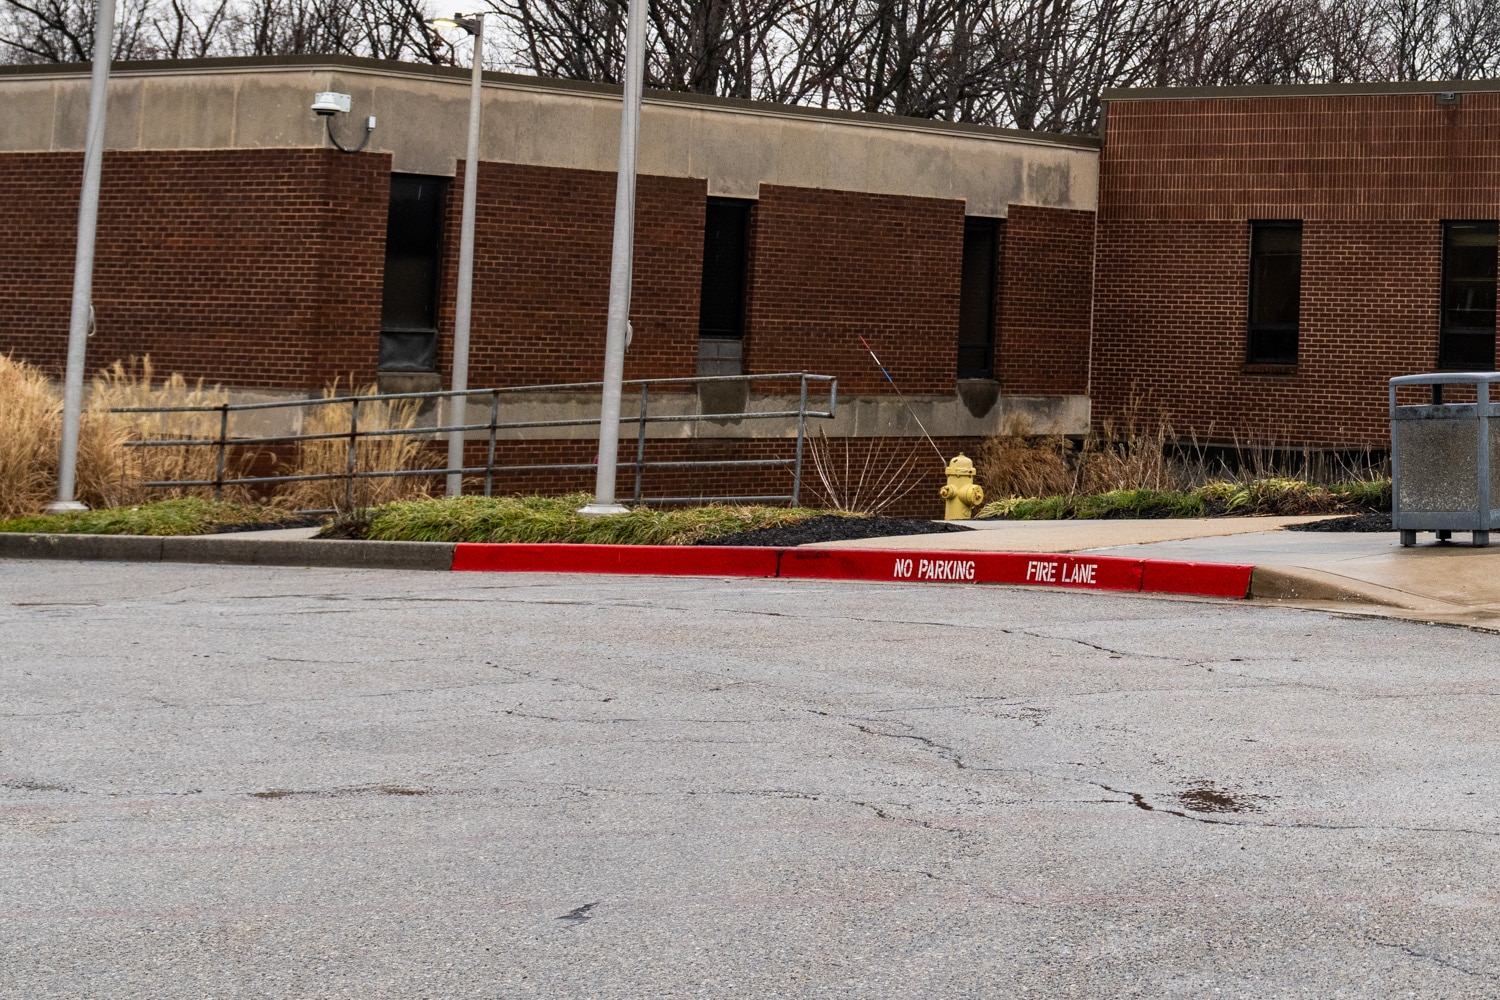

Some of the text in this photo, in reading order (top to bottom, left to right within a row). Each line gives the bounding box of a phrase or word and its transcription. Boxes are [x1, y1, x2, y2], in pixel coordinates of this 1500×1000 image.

[893, 558, 1098, 584] NO PARKING FIRE LANE
